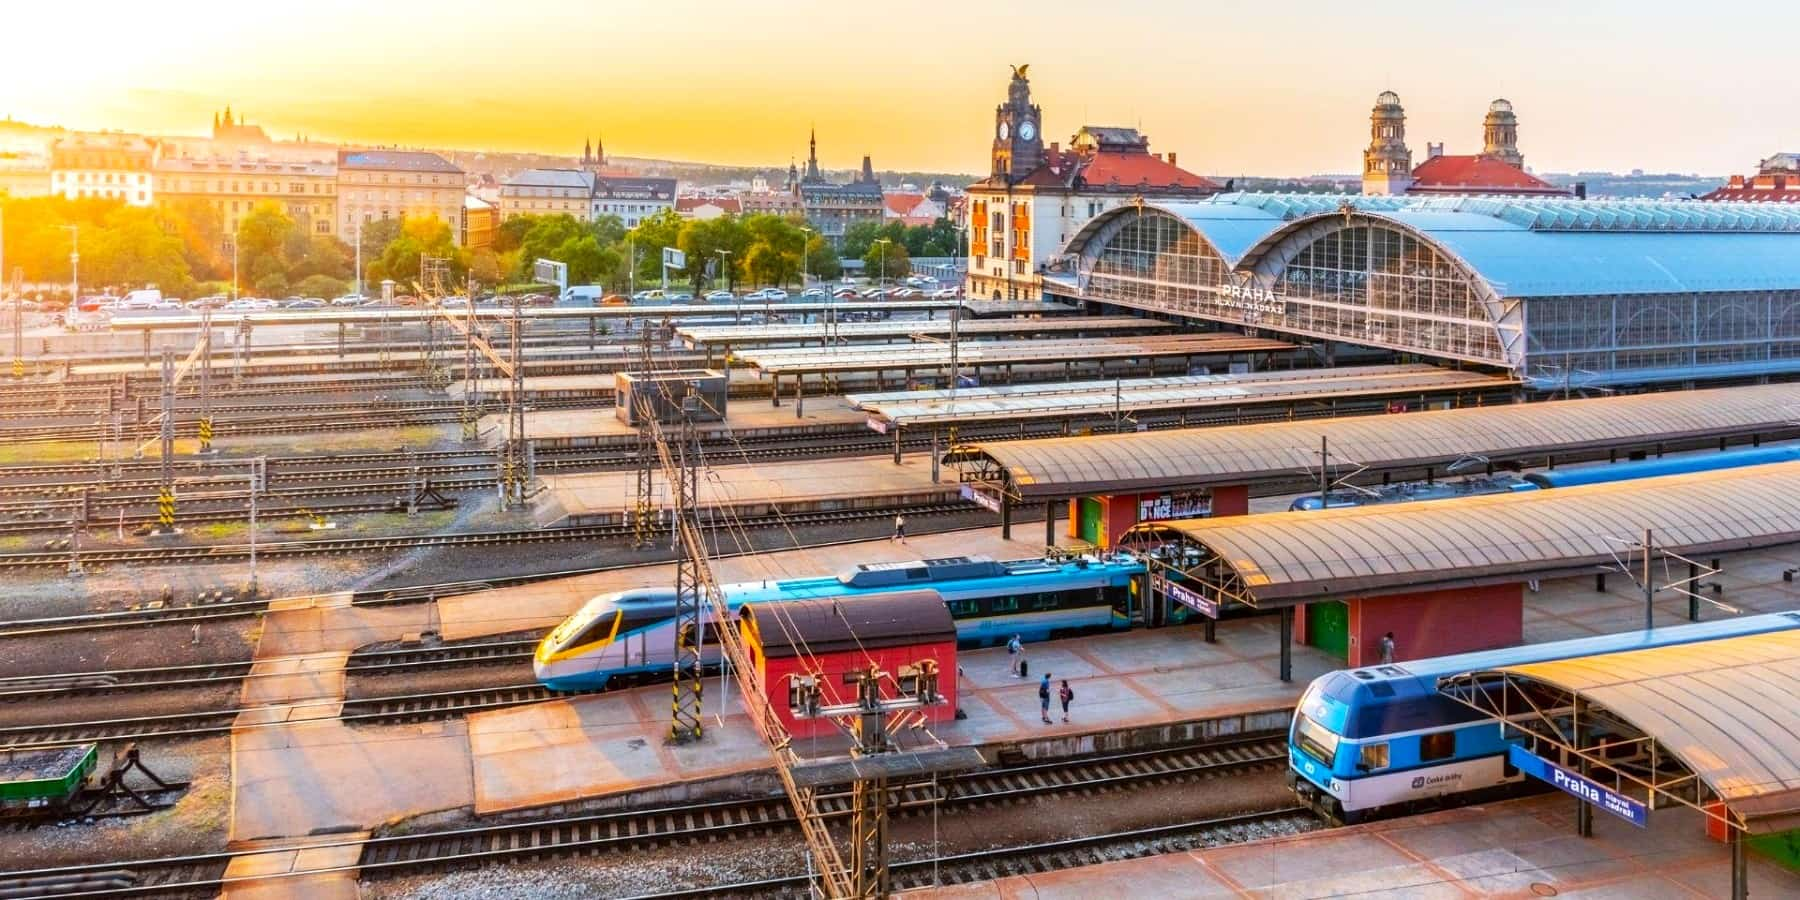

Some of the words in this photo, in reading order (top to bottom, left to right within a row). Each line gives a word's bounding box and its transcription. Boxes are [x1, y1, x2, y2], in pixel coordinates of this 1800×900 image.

[1222, 284, 1276, 303] PRAHA
[1172, 586, 1195, 606] Praha
[1554, 769, 1600, 802] Praha
